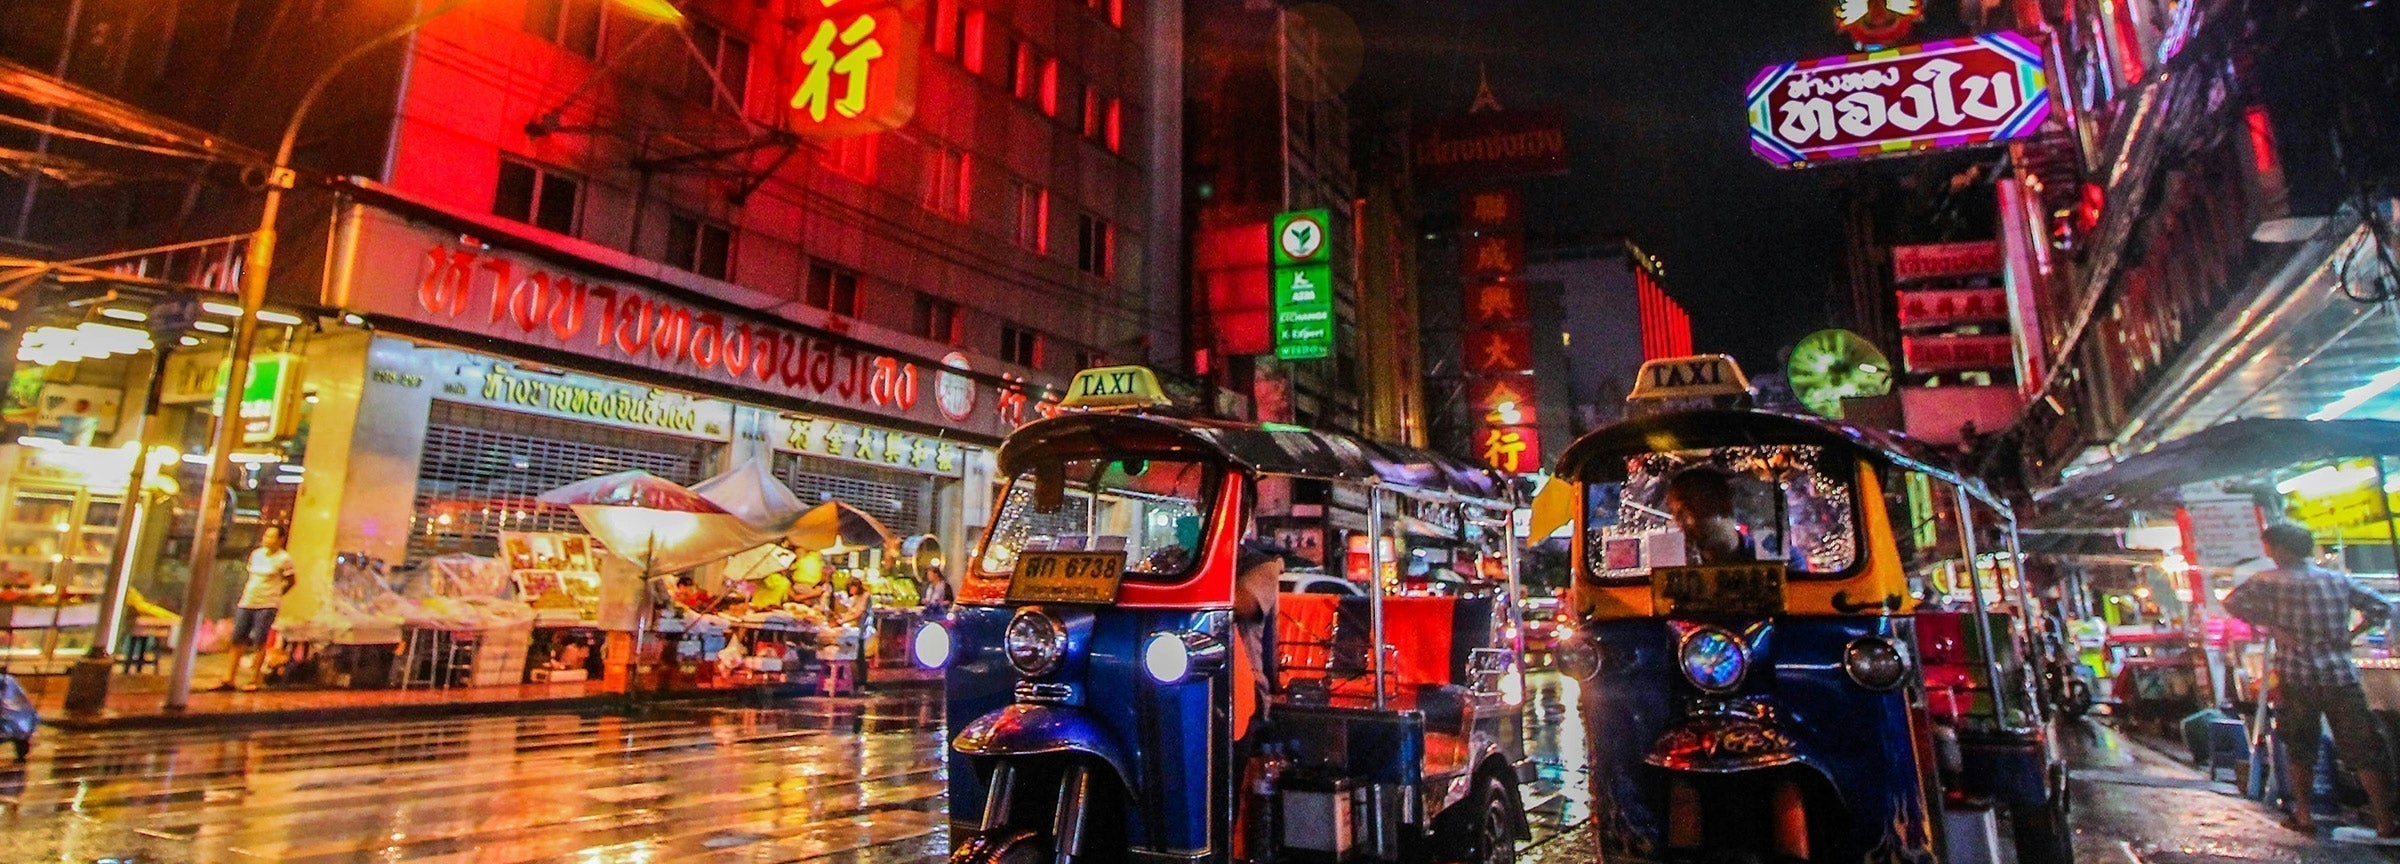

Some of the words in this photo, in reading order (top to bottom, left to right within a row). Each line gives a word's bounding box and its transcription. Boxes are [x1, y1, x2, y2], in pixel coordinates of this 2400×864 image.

[790, 0, 883, 122] 行
[1778, 58, 2015, 143] ทองใบ
[1081, 371, 1136, 396] TAXI
[1647, 360, 1720, 387] TAXI
[1065, 557, 1117, 578] 6738
